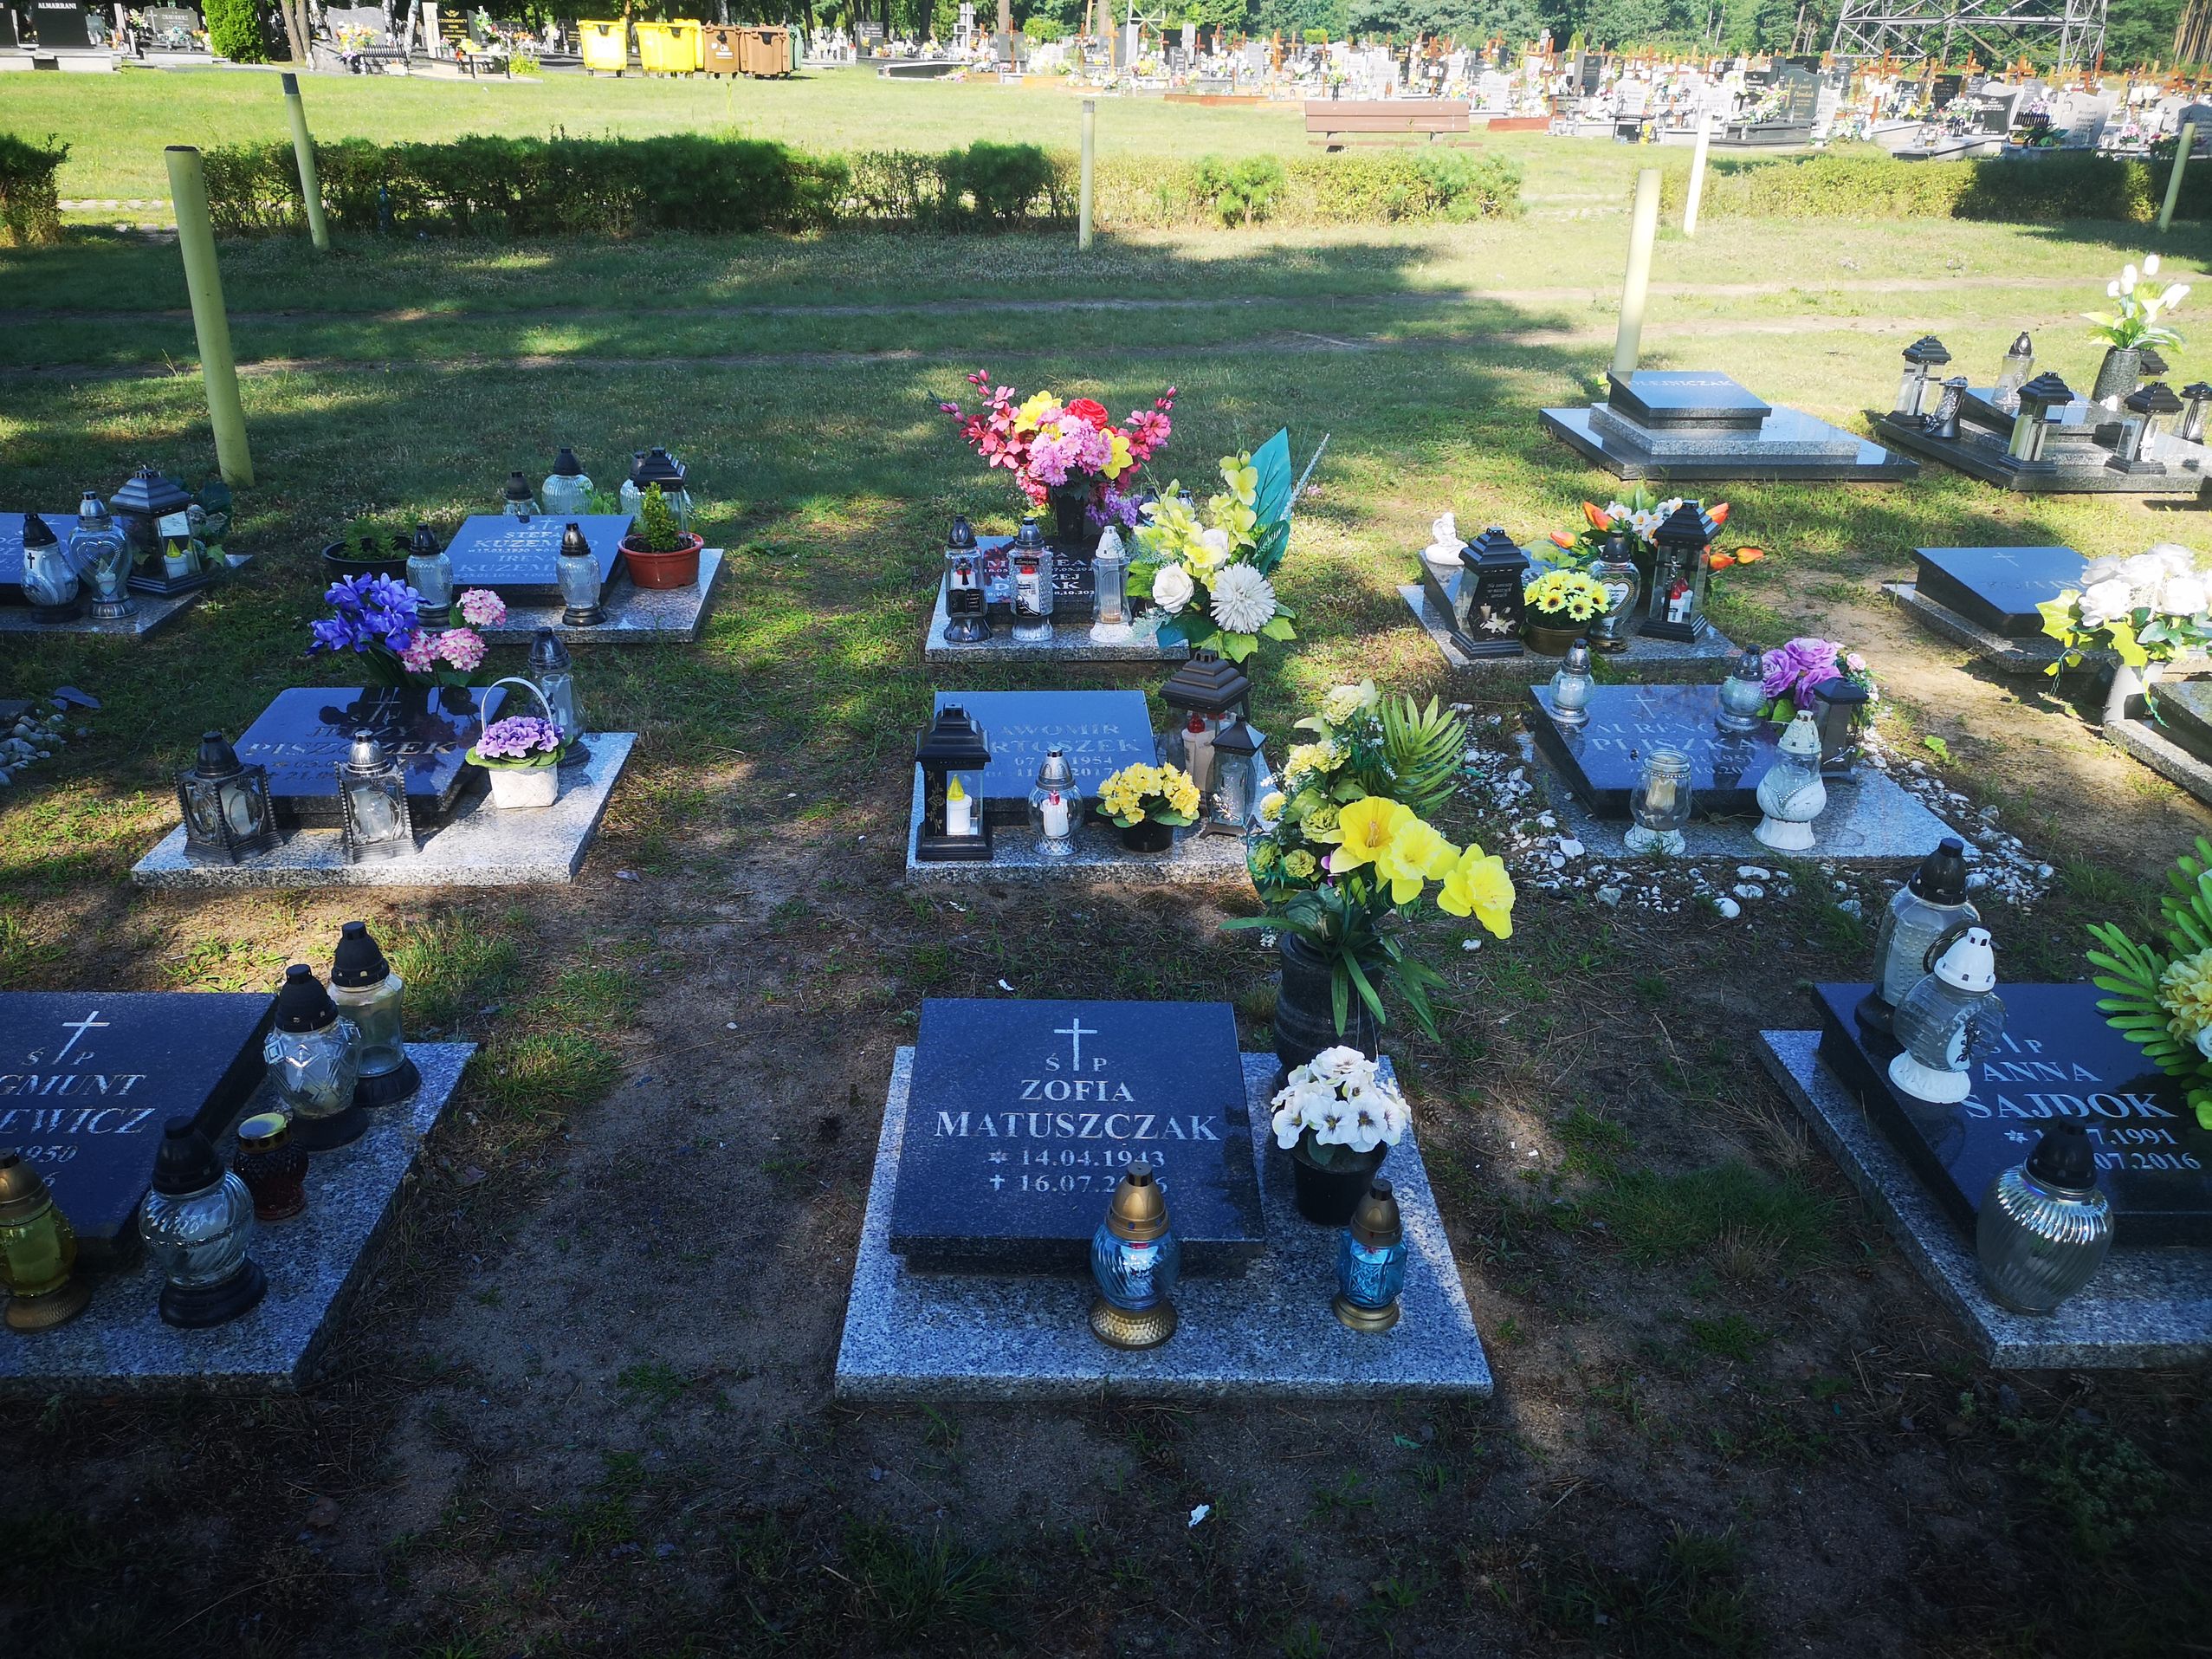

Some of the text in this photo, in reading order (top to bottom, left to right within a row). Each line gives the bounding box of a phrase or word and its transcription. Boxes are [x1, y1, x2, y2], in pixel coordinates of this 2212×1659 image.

[990, 740, 1142, 753] RTOSZEK
[69, 1051, 95, 1066] P
[1093, 1057, 1108, 1072] P
[1982, 1061, 2103, 1082] ANNA
[0, 1074, 147, 1096] GMUNT
[1019, 1079, 1136, 1102] ZOFIA
[1961, 1093, 2179, 1118] SAJDOK
[0, 1108, 157, 1134] EWICZ
[934, 1111, 1220, 1141] MATUSZCZAK
[1021, 1150, 1165, 1167] 14.04.1943
[2092, 1152, 2202, 1170] 07.2016
[1020, 1174, 1168, 1194] 16.07.26
